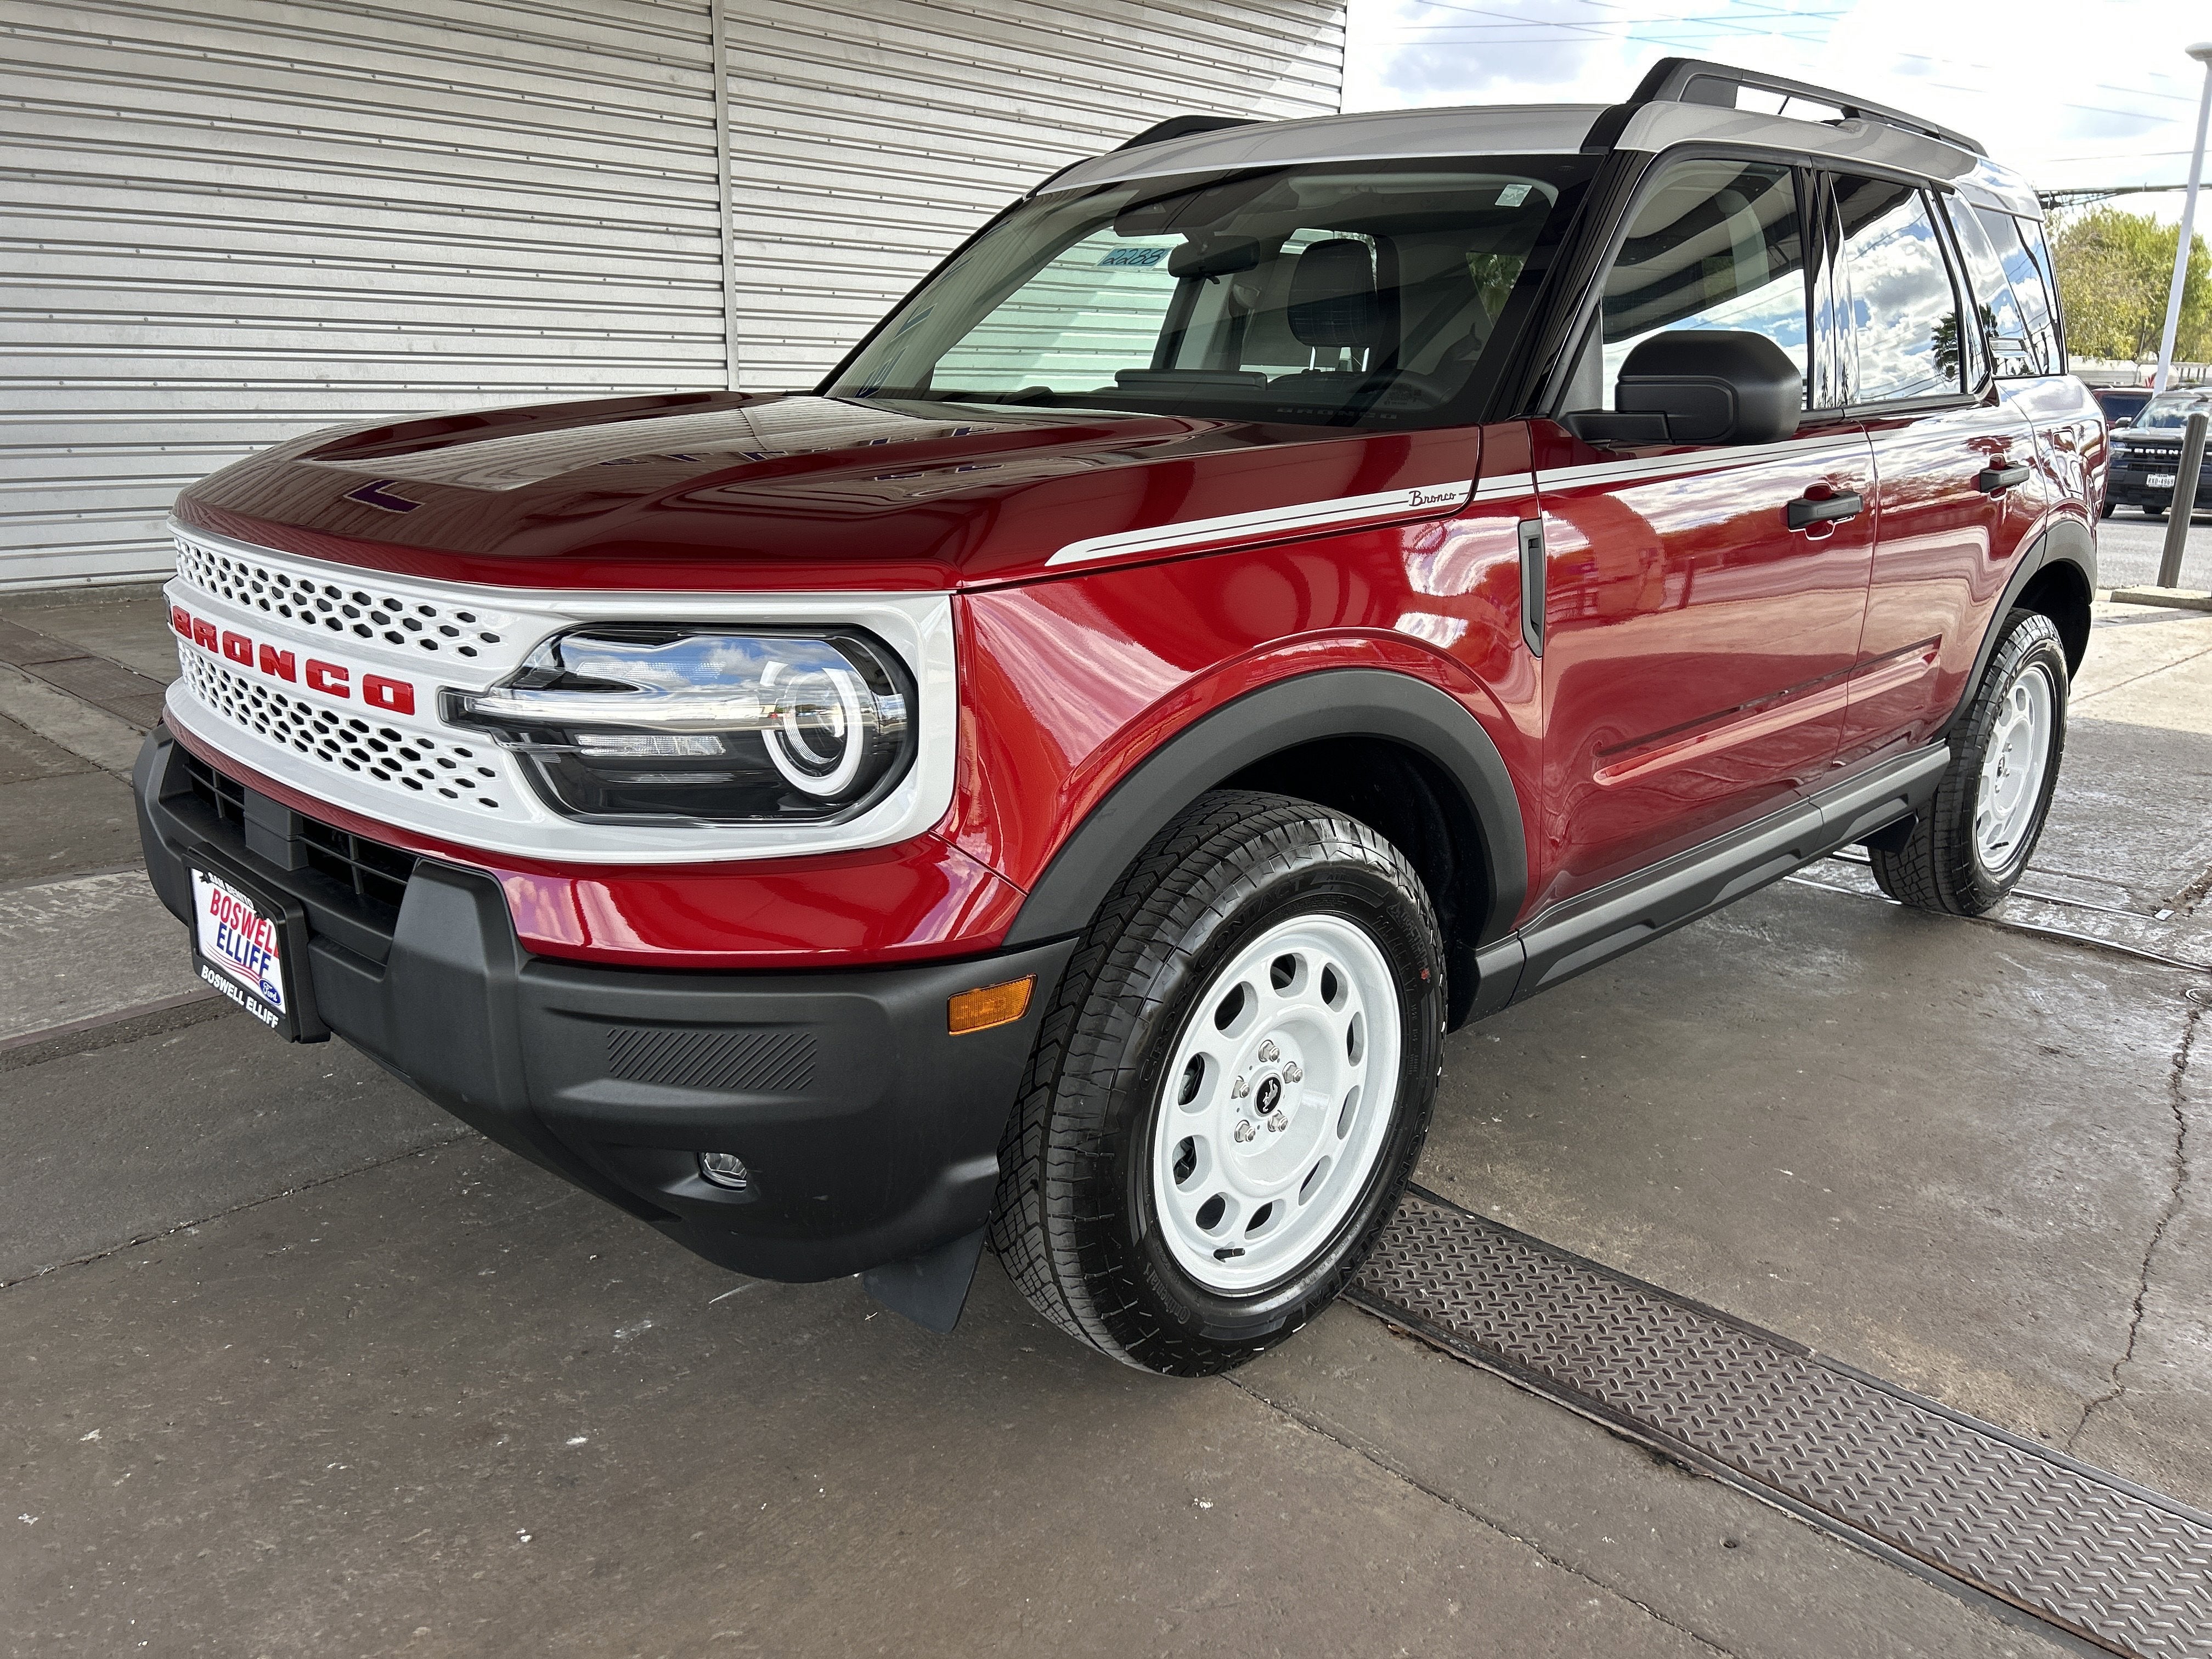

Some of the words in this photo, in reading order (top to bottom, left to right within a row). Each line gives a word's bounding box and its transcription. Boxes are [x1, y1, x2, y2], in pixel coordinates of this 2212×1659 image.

[1102, 248, 1165, 264] 2288
[1277, 408, 1397, 419] BRONCO
[1408, 490, 1456, 506] Bronco
[172, 605, 415, 715] BRONCO
[208, 872, 225, 890] SAN
[224, 882, 254, 909] BENITO
[216, 921, 272, 978] ELLIFF
[201, 964, 245, 1006] BOSWELL
[246, 996, 279, 1028] ELLIFF
[263, 982, 278, 1001] Ford
[1146, 1269, 1191, 1324] Continental
